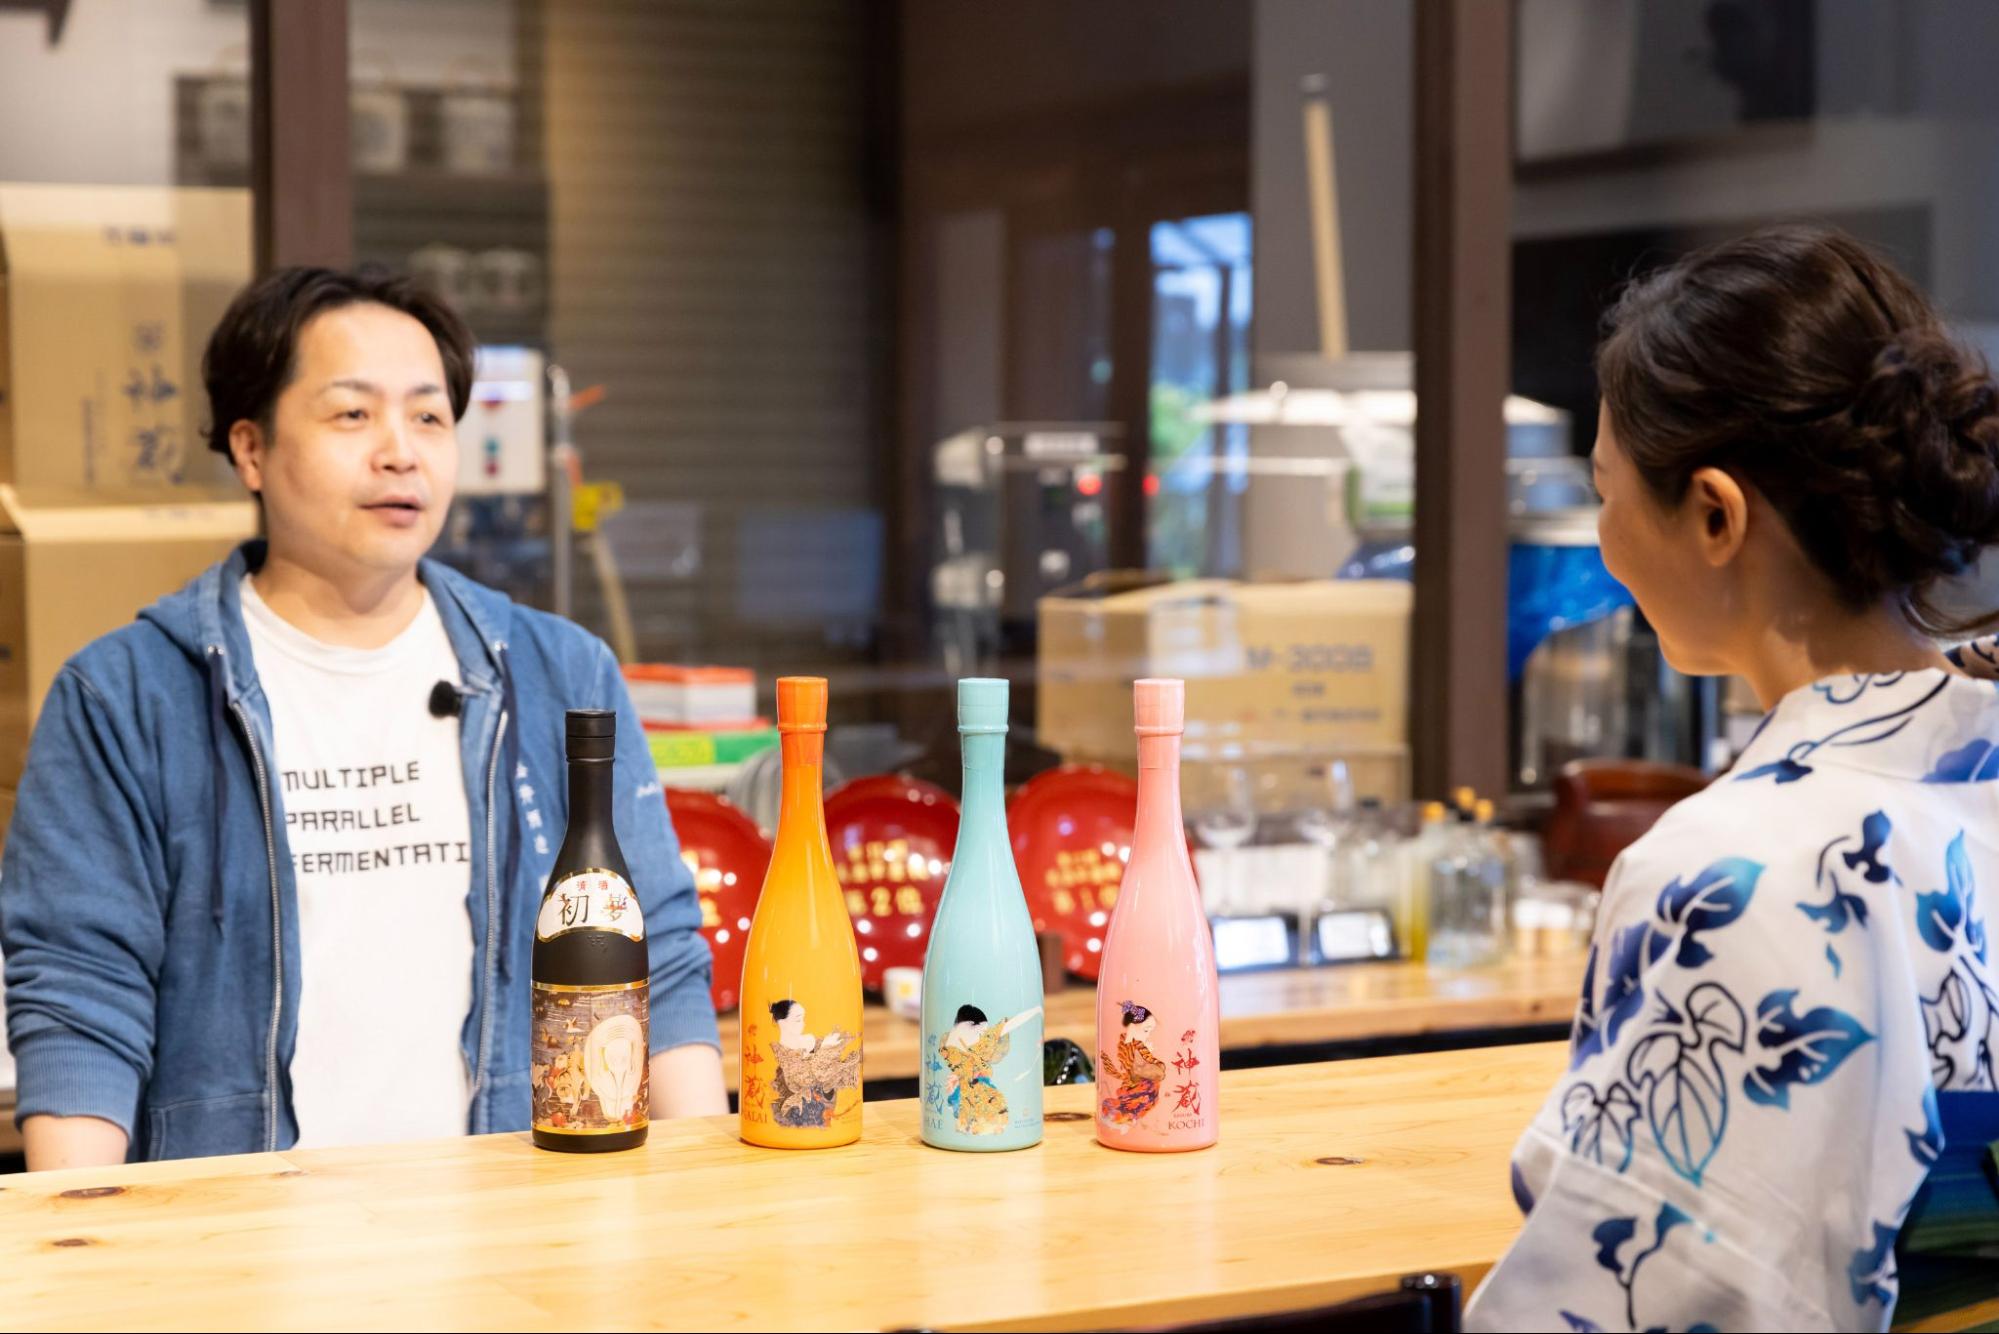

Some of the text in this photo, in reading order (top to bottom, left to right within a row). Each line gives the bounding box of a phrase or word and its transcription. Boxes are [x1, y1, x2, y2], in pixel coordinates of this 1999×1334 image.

[282, 761, 420, 792] MULTIPLE
[286, 803, 420, 832] PARALLEL
[1168, 1119, 1205, 1130] KOCHI
